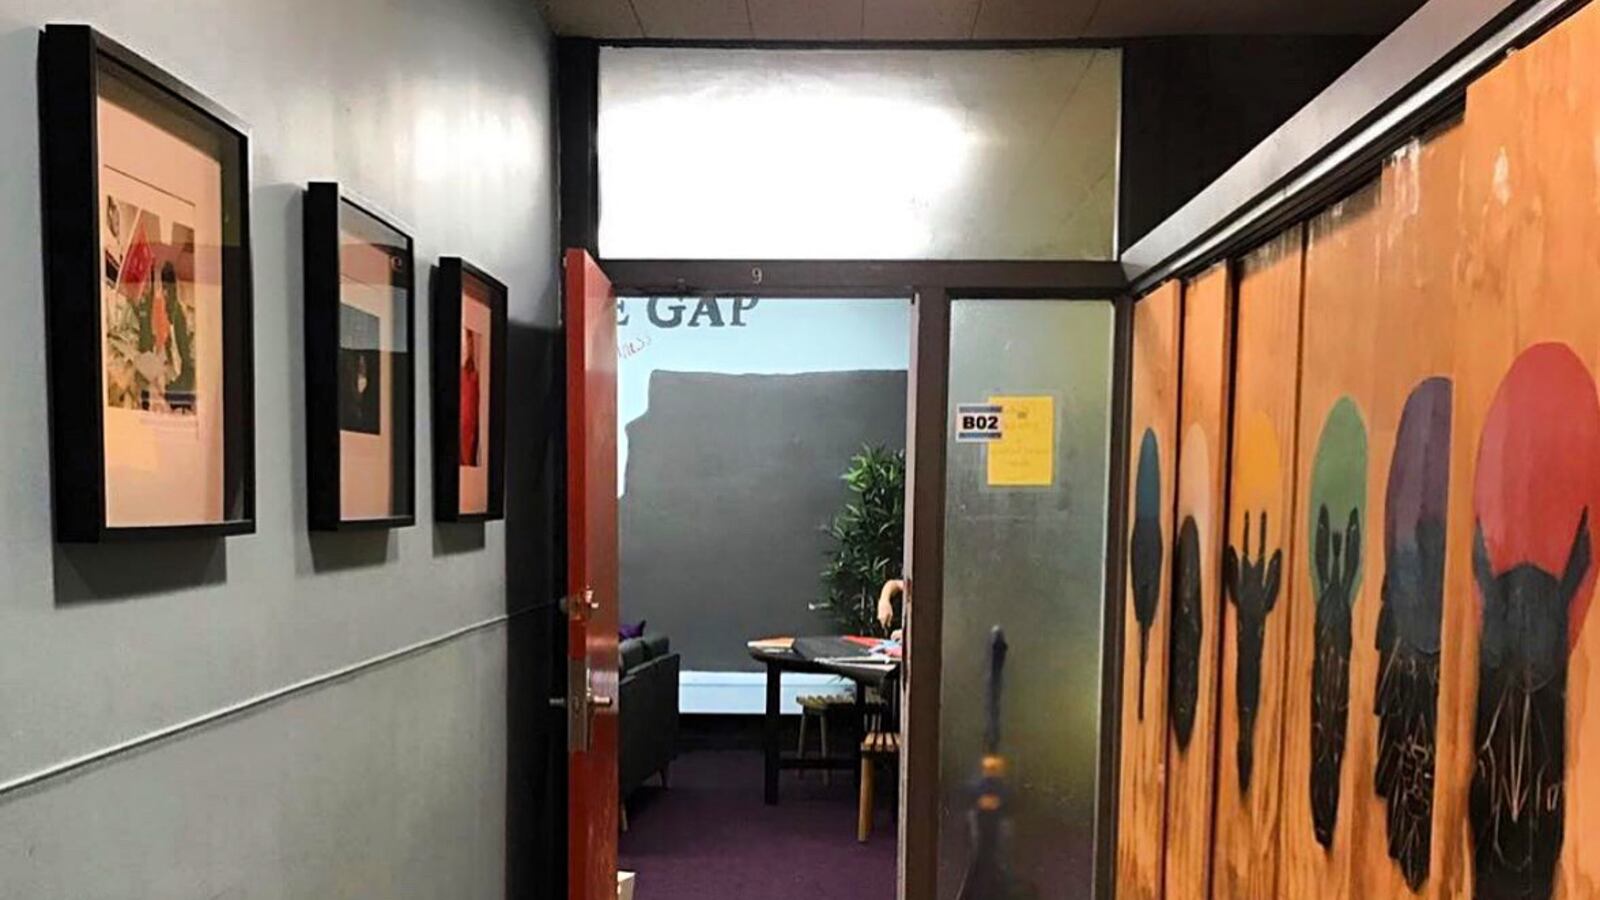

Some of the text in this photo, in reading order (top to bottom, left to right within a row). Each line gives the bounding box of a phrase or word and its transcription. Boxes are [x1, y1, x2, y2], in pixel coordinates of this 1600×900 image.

[751, 267, 763, 284] 9
[646, 296, 760, 328] GAP
[962, 416, 999, 430] B02
